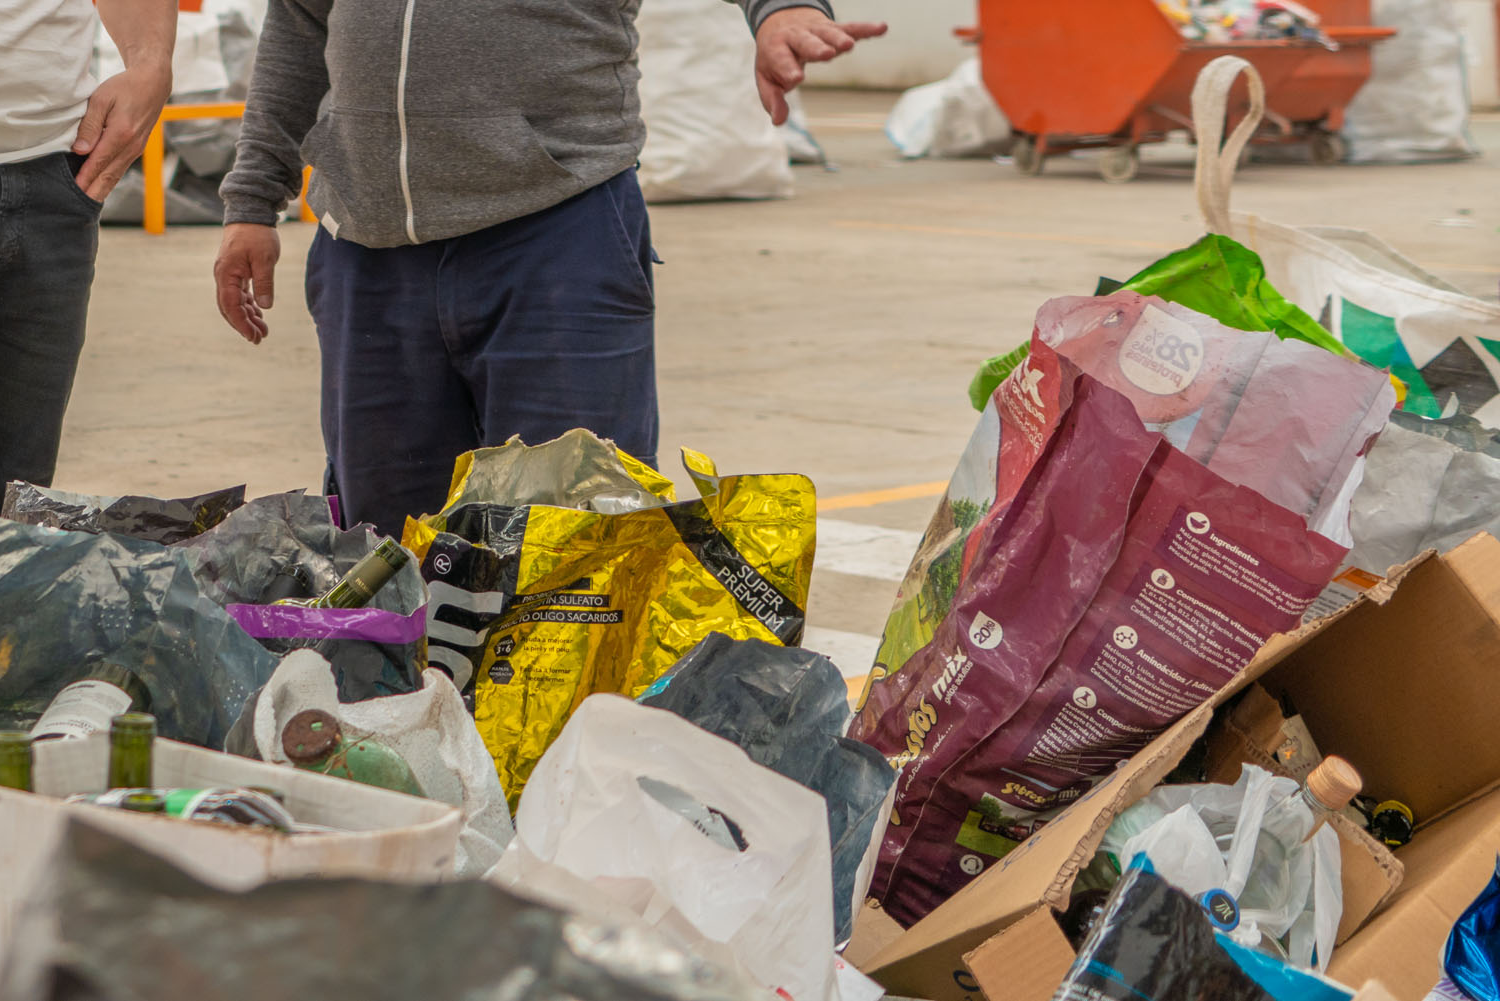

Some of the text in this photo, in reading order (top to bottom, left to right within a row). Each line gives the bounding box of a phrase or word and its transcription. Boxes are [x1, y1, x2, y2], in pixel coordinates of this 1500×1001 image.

[1208, 531, 1260, 568] Ingredientes
[559, 594, 603, 606] SULFATO
[717, 566, 785, 632] PREMIUM
[736, 565, 784, 612] SUPER
[532, 611, 565, 621] OLIGO
[567, 612, 619, 622] SACARIDOS
[1175, 585, 1266, 647] Componentes vitamínic
[931, 645, 968, 700] mix
[1135, 647, 1187, 685] Aminoácidos
